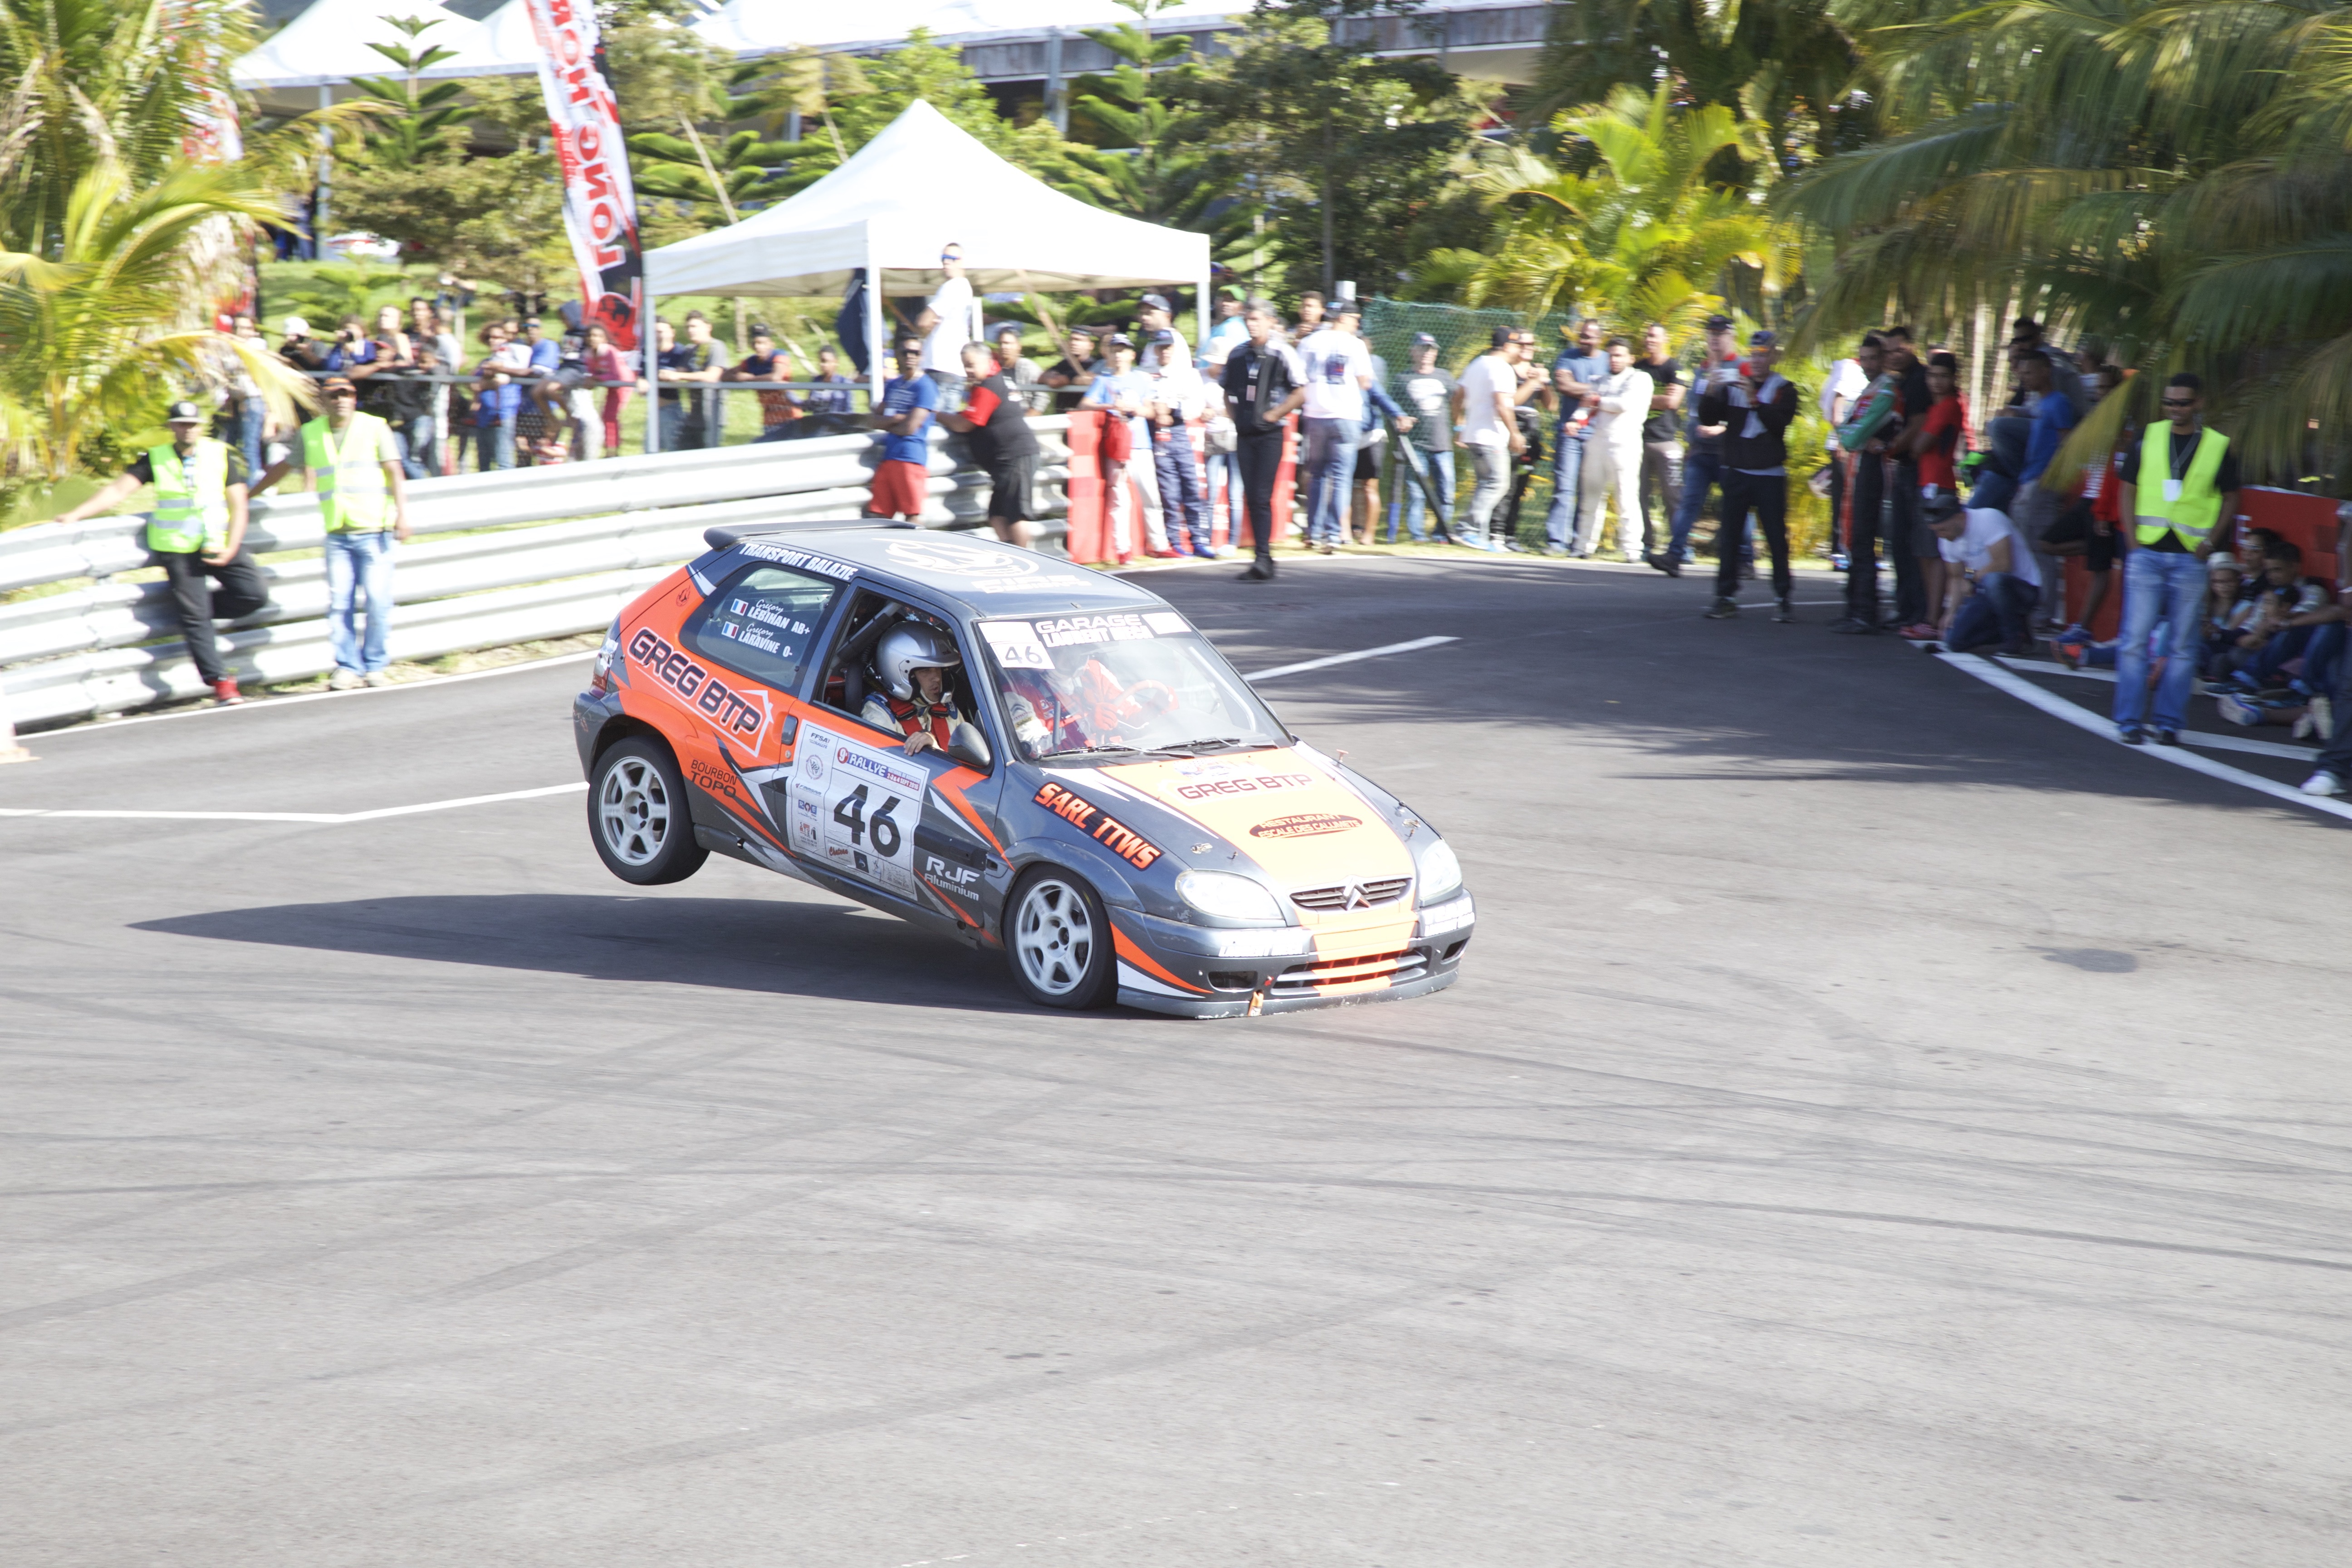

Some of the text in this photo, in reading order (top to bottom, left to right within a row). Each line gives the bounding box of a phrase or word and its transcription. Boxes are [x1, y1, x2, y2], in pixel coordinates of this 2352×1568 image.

[739, 544, 858, 580] TRANSPORT BALAZIE
[756, 599, 784, 614] Gregory
[746, 623, 774, 639] Gregory
[747, 607, 810, 635] LEBIHAN AB+
[1035, 614, 1142, 634] GARAGE
[738, 631, 780, 653] LARAVINE
[1004, 646, 1043, 664] 46
[627, 627, 763, 735] GREG BTP
[691, 759, 737, 785] BOURBON
[849, 754, 887, 776] RALLYE
[691, 770, 736, 798] TOPO
[1177, 774, 1313, 799] GREG BTP
[834, 784, 901, 857] 46
[1034, 783, 1161, 869] SARL TTWS
[1258, 820, 1360, 838] ESCALE DES CALUMETS
[1259, 813, 1342, 828] RESTAURANT
[926, 856, 980, 884] RJF
[924, 873, 979, 901] Aluminium
